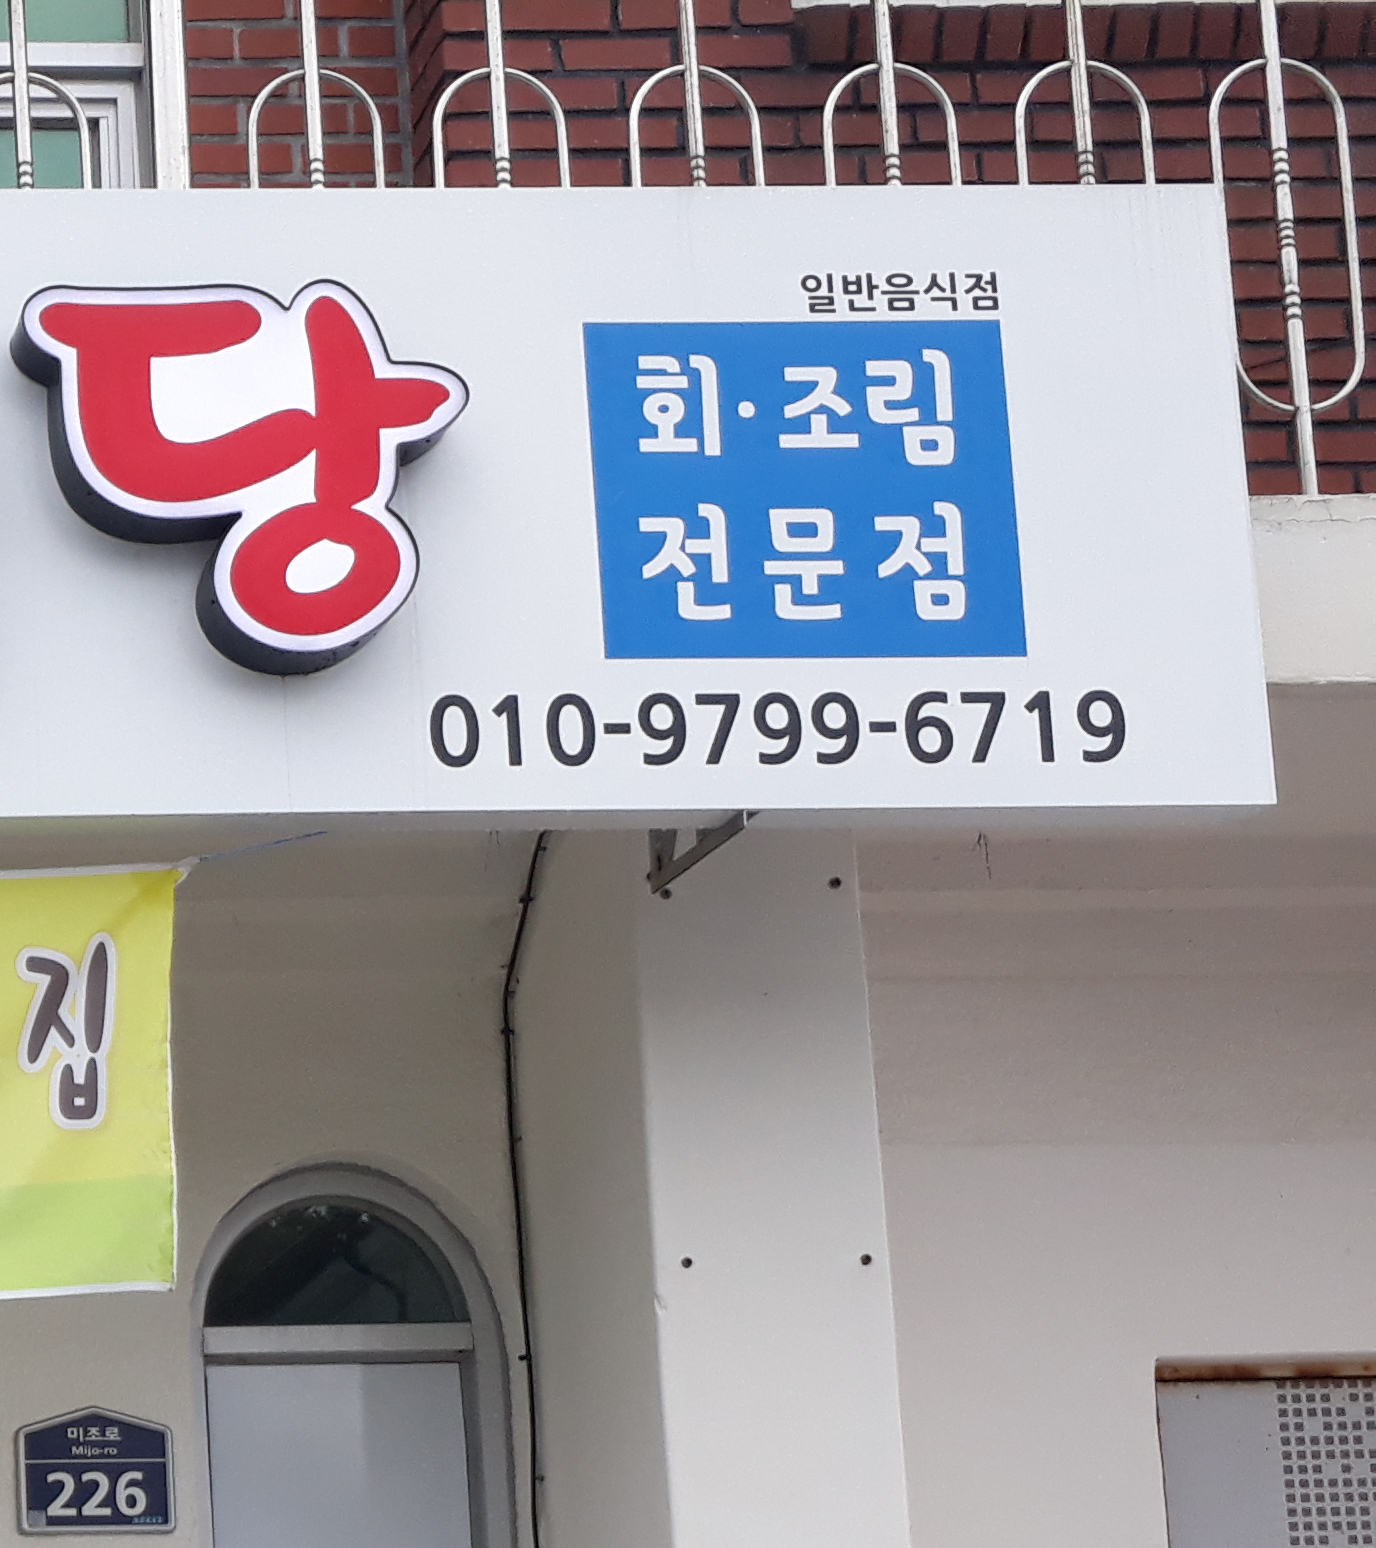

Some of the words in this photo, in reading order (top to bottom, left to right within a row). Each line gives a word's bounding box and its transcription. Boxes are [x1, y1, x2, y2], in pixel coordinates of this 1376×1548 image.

[799, 271, 1001, 313] 일반음식점
[637, 500, 968, 622] 전문점
[428, 688, 1128, 767] 010-9799-6719
[20, 934, 113, 1125] 집
[67, 1427, 121, 1442] 미조로
[71, 1445, 118, 1457] Mijo-ro
[46, 1471, 147, 1517] 226
